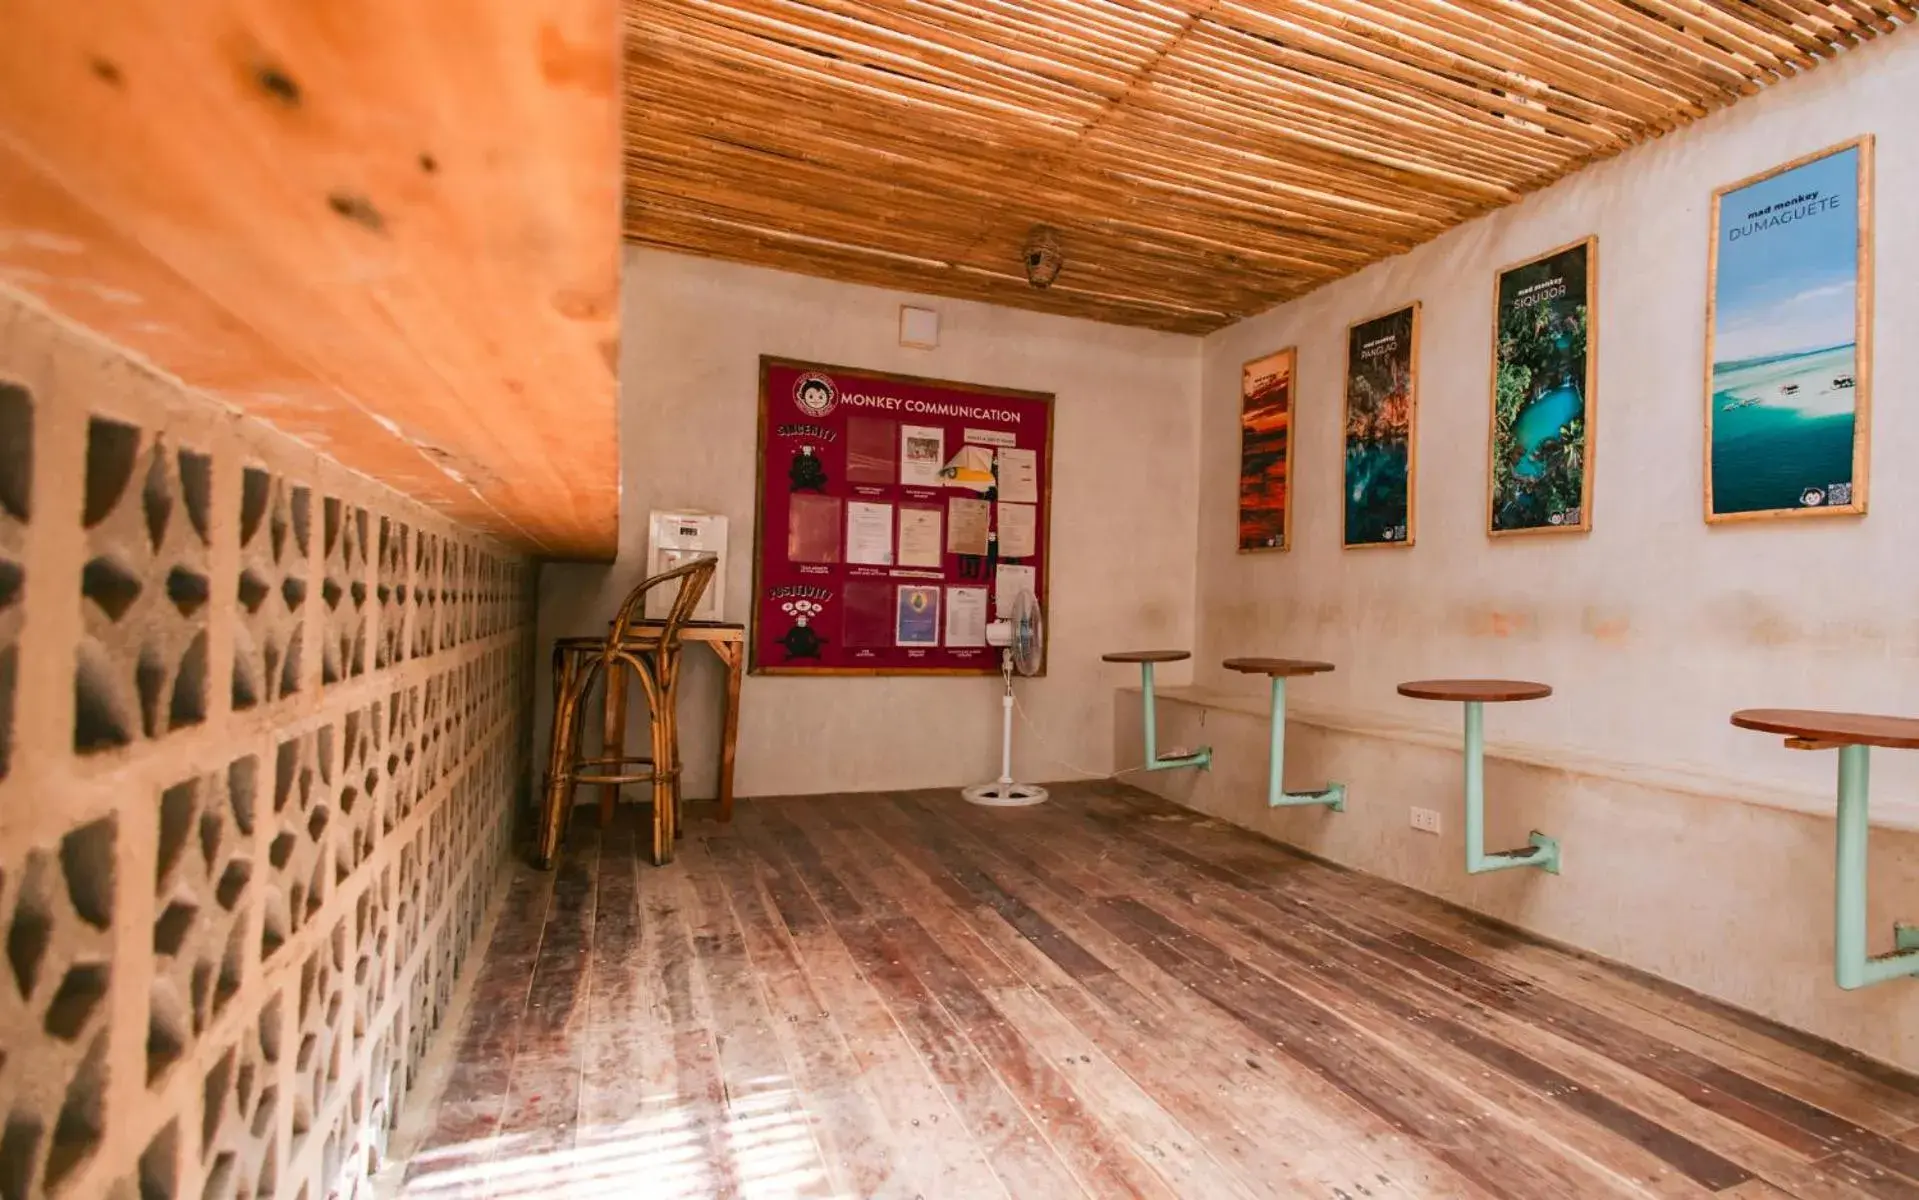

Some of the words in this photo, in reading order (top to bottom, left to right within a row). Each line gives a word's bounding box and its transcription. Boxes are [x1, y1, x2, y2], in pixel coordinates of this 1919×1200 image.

[1729, 195, 1840, 242] DUMAGUETE
[1747, 205, 1771, 219] mad
[1773, 191, 1819, 211] monkey
[840, 393, 903, 410] MONKEY
[904, 399, 1021, 424] COMMUNICATION
